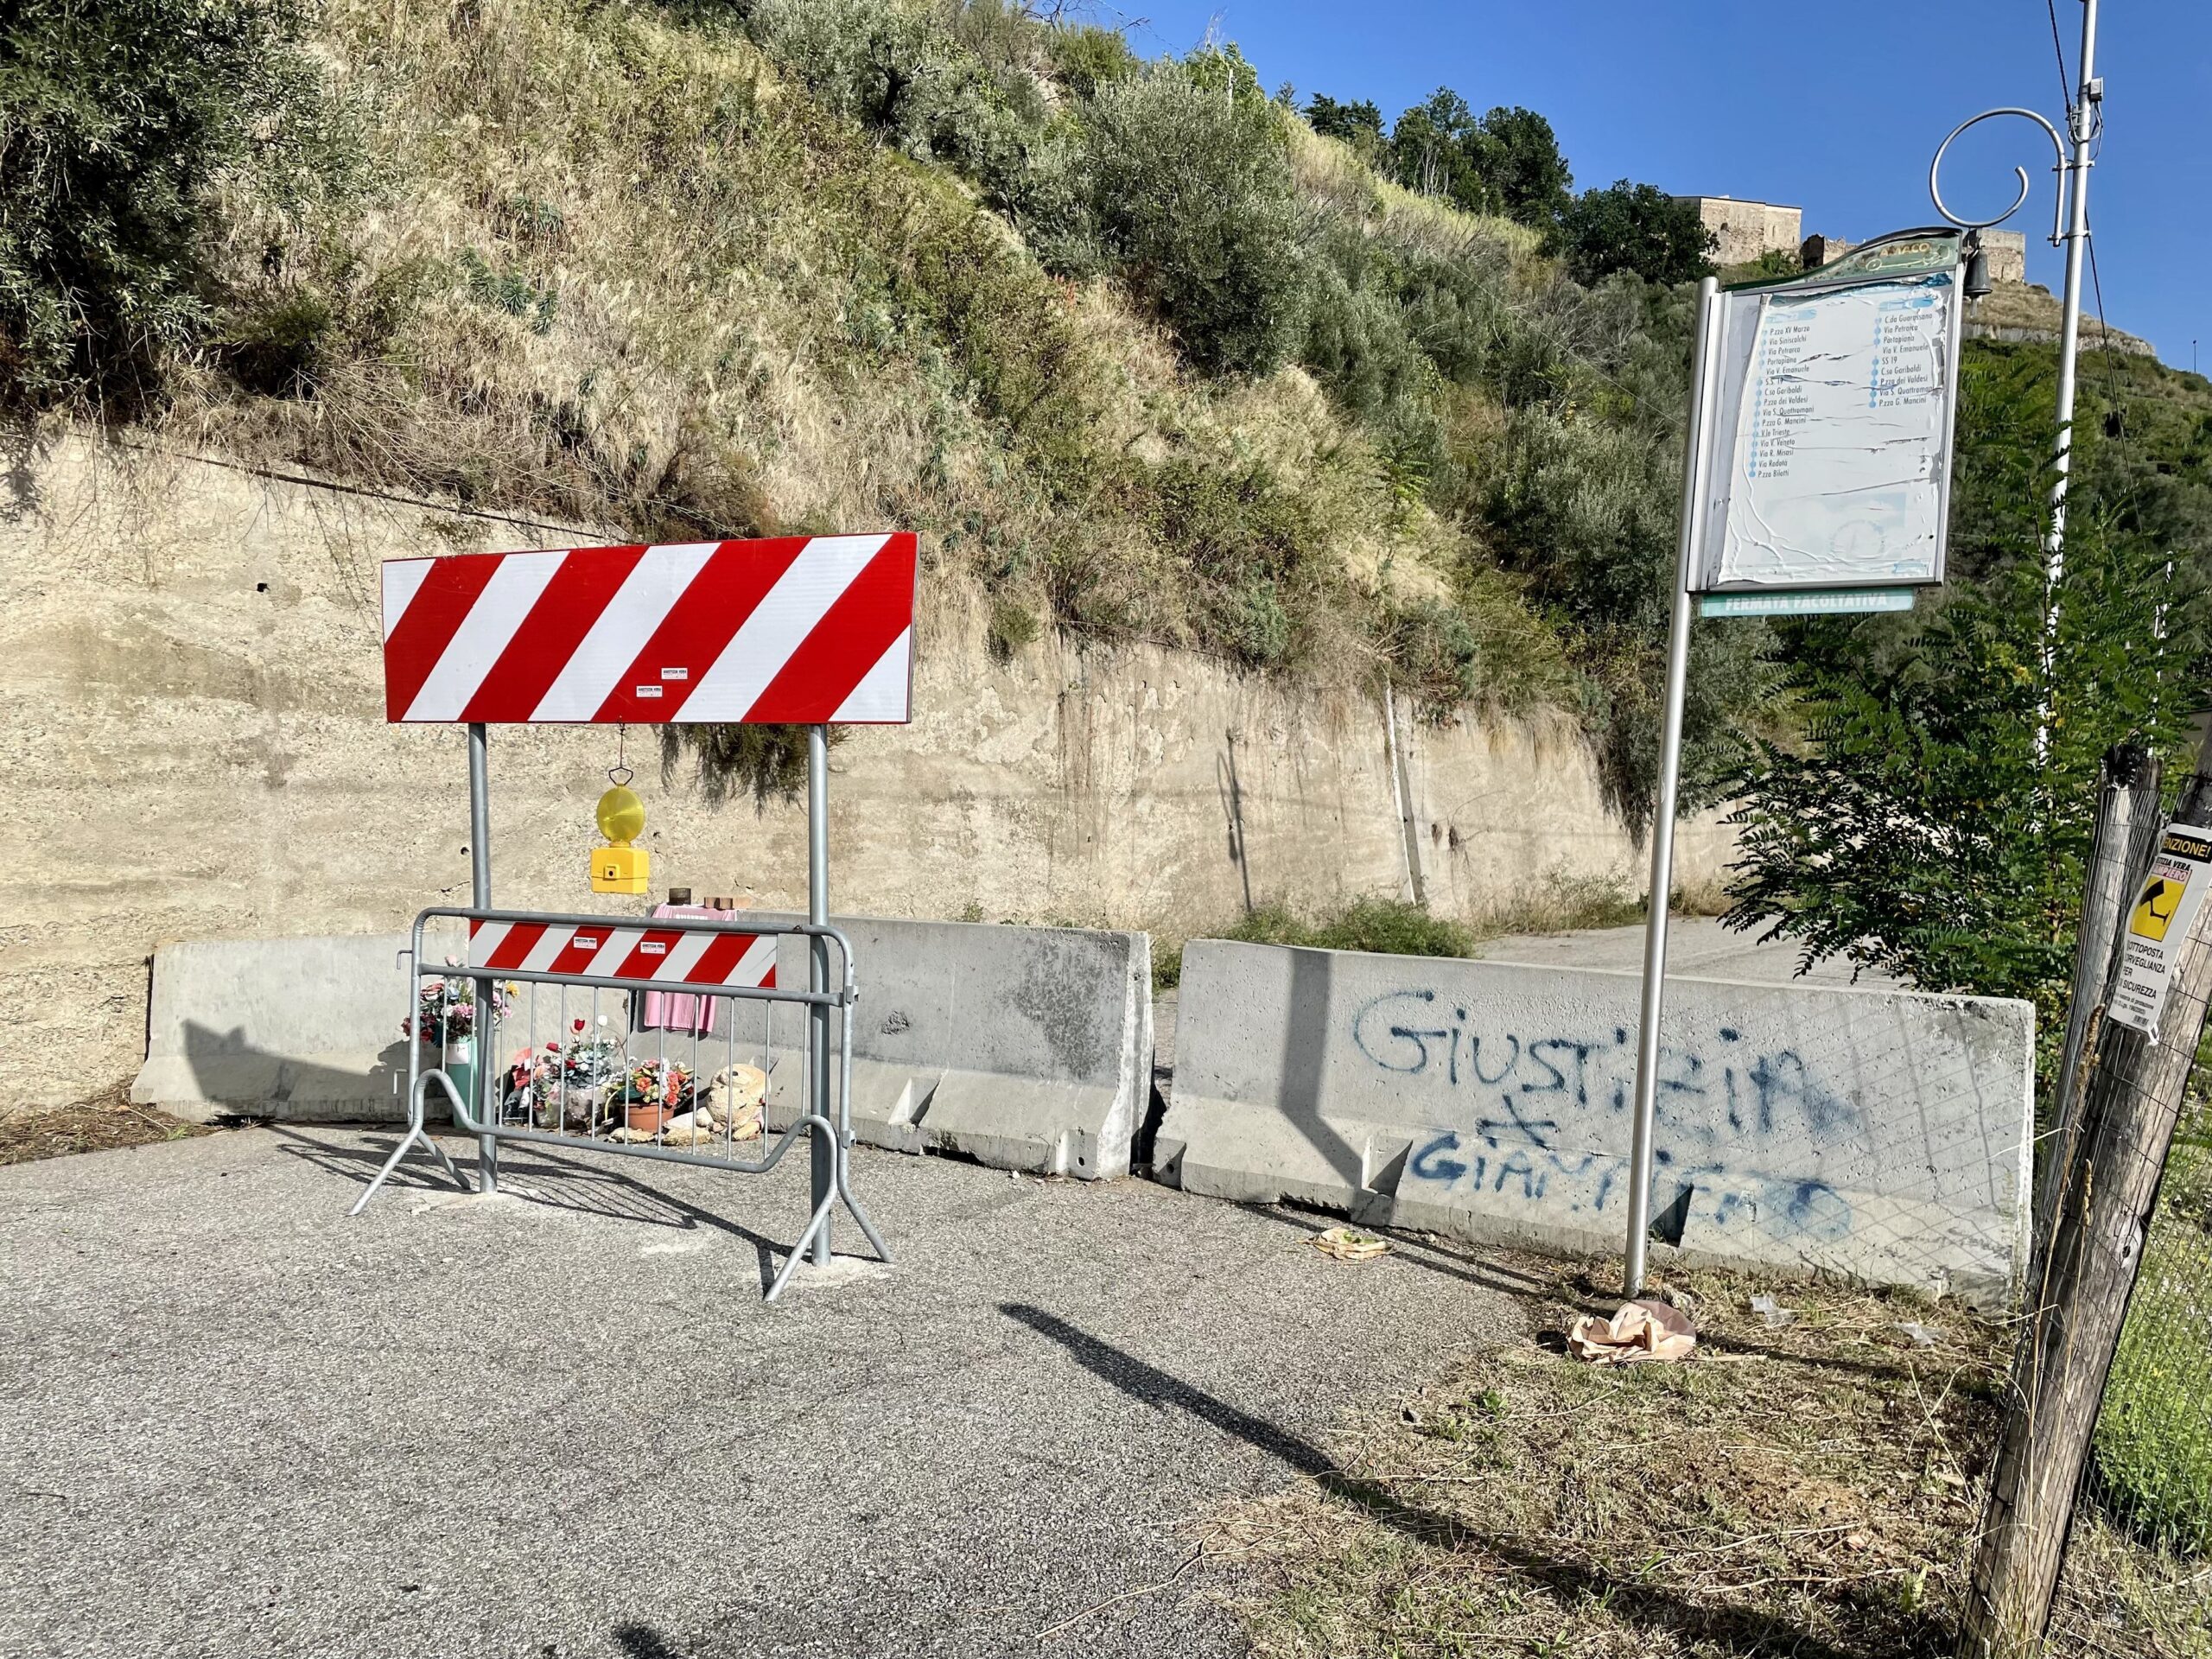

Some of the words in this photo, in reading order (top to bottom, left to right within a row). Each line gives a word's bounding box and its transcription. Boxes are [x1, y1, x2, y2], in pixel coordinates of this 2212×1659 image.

[1780, 335, 1807, 344] Siniscalchi
[1900, 343, 1928, 353] Emanuele
[1783, 364, 1809, 374] Emanuele
[1894, 364, 1921, 374] Garibaldi
[1907, 375, 1928, 384] Valdesi
[1777, 385, 1802, 394] Garibaldi
[1789, 395, 1808, 404] Valdesi
[1904, 397, 1926, 405] Mancini
[1780, 405, 1814, 415] Quattromani
[1726, 597, 1789, 610] FERMATA
[1794, 593, 1887, 609] FACOLTATIVA
[2173, 861, 2191, 871] VERA
[2123, 979, 2156, 999] SICUREZZA
